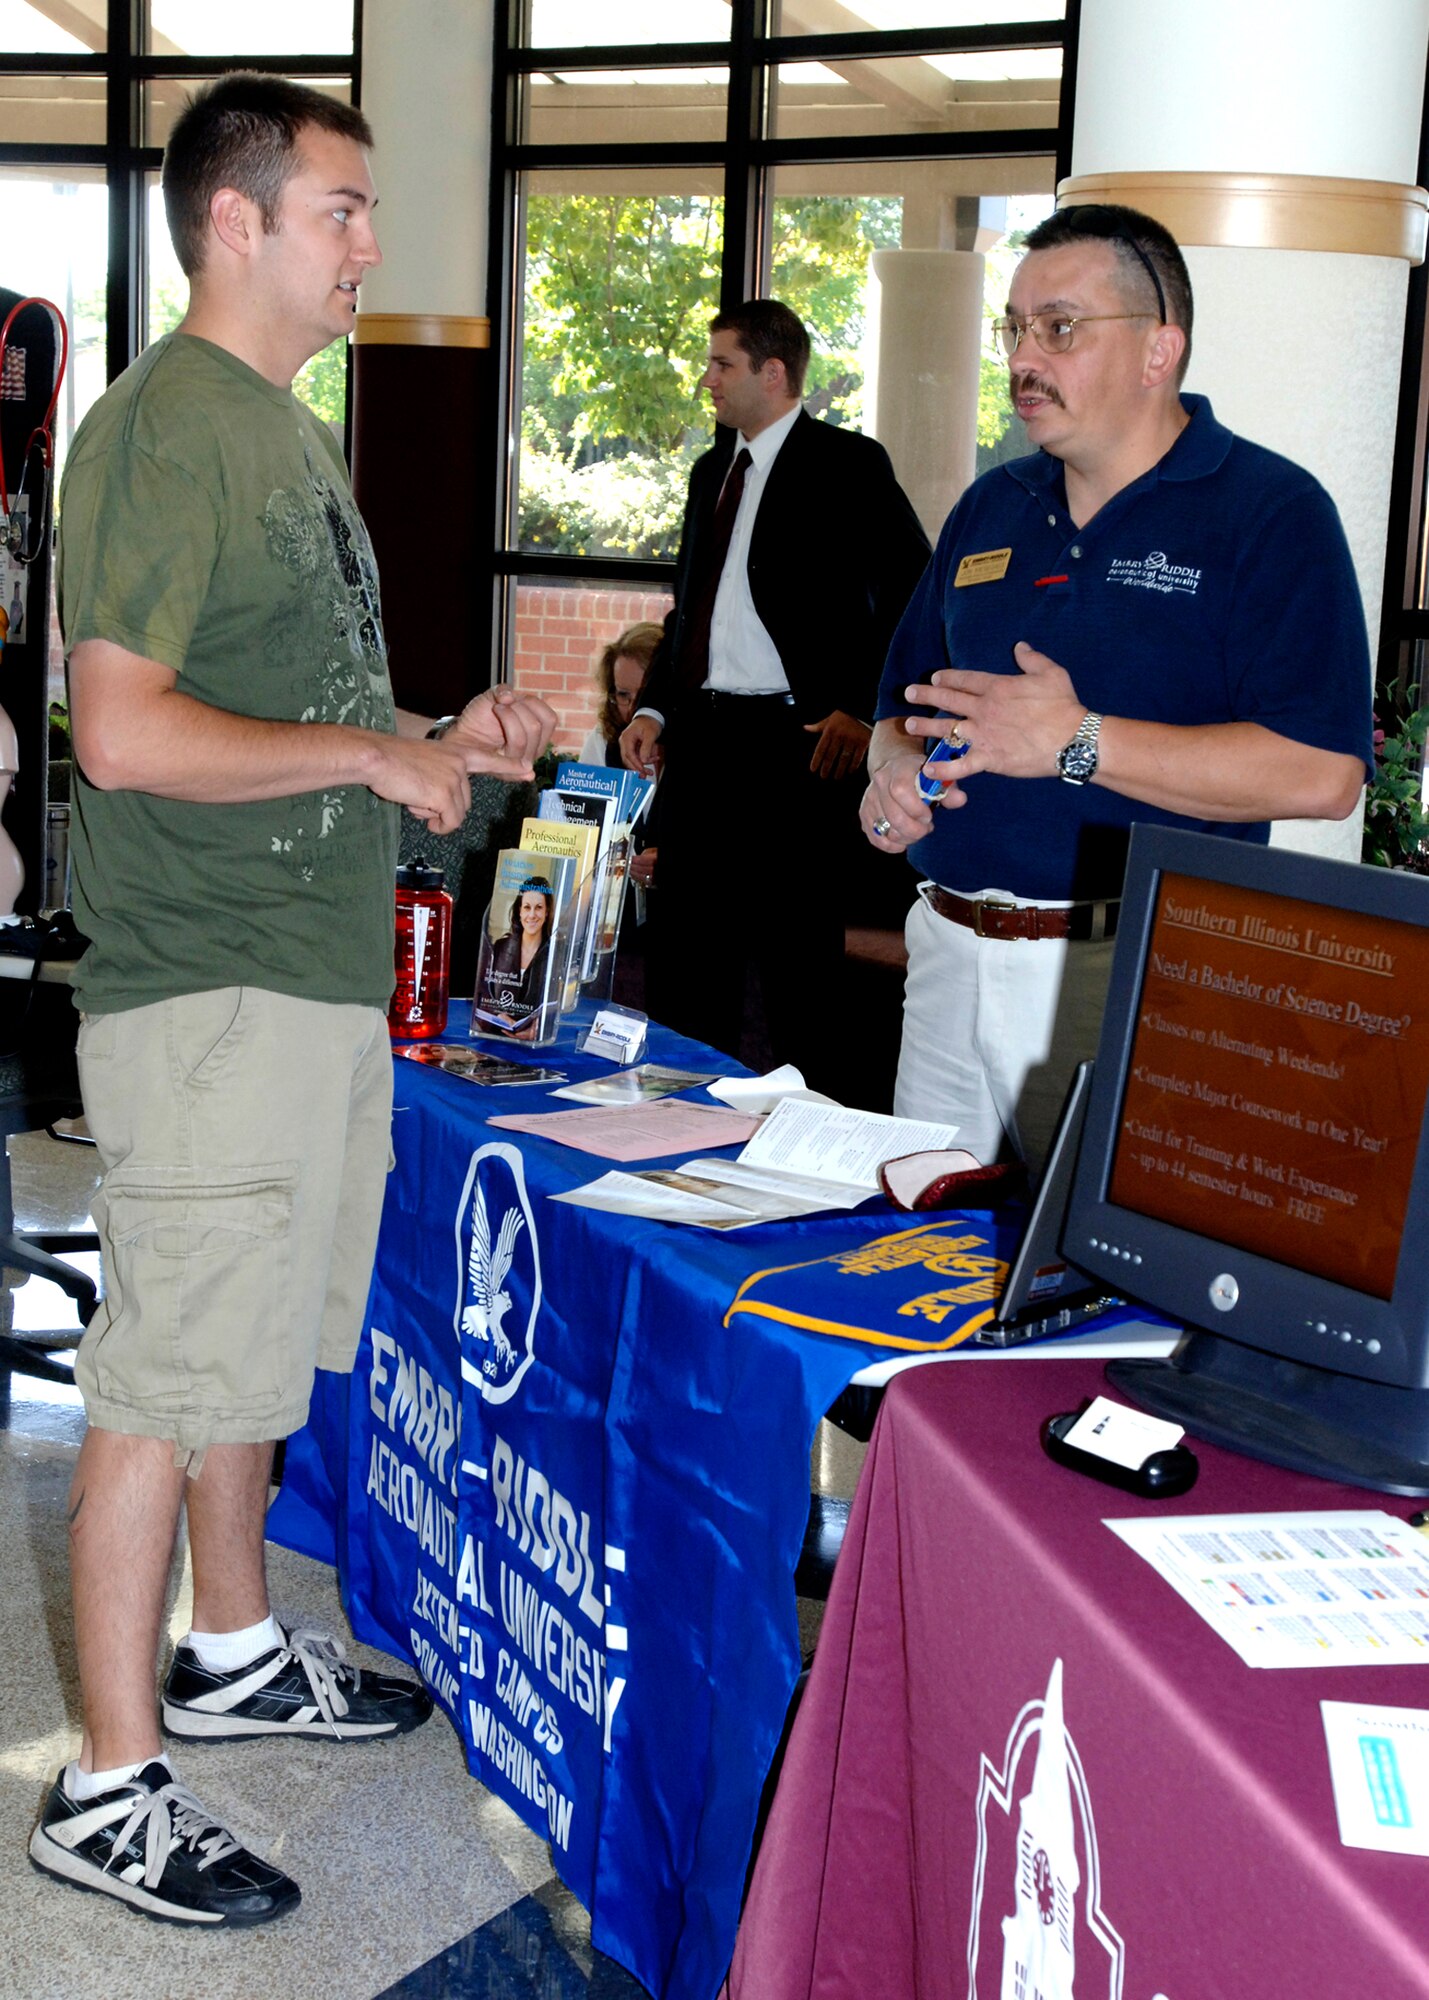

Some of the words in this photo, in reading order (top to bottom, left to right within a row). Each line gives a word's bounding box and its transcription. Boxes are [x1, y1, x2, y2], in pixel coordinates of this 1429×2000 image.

[1158, 573, 1199, 589] university
[1160, 564, 1202, 579] RIDDLE
[558, 773, 614, 792] Aeronautical
[567, 768, 587, 780] Master
[587, 771, 595, 780] of
[525, 823, 577, 846] Professional
[531, 840, 582, 858] Aeronautics
[1163, 898, 1236, 935] Southern
[1241, 914, 1300, 950] Illinois
[1304, 929, 1397, 972] University
[1152, 953, 1188, 981] Need
[1188, 967, 1197, 983] a
[1201, 965, 1264, 1000] Bachelor
[1265, 983, 1285, 1005] of
[1284, 986, 1342, 1020] Science
[1345, 1000, 1411, 1036] Degree?
[1190, 1028, 1205, 1043] on
[1207, 1029, 1274, 1067] Alternating
[1277, 1046, 1346, 1081] Weekends!
[1194, 1080, 1229, 1108] Major
[1230, 1093, 1303, 1129] Coursework
[1306, 1119, 1319, 1134] in
[1321, 1120, 1349, 1144] One
[1352, 1126, 1388, 1153] Year!
[1139, 1154, 1156, 1174] up
[1156, 1156, 1170, 1173] to
[1171, 1160, 1185, 1178] 44
[1188, 1168, 1238, 1196] semester
[1165, 1129, 1182, 1149] for
[1186, 1134, 1234, 1171] Training
[1235, 1153, 1249, 1171] &
[1252, 1155, 1286, 1185] Work
[1287, 1167, 1359, 1207] Experience
[468, 1699, 574, 1853] WASHINGON
